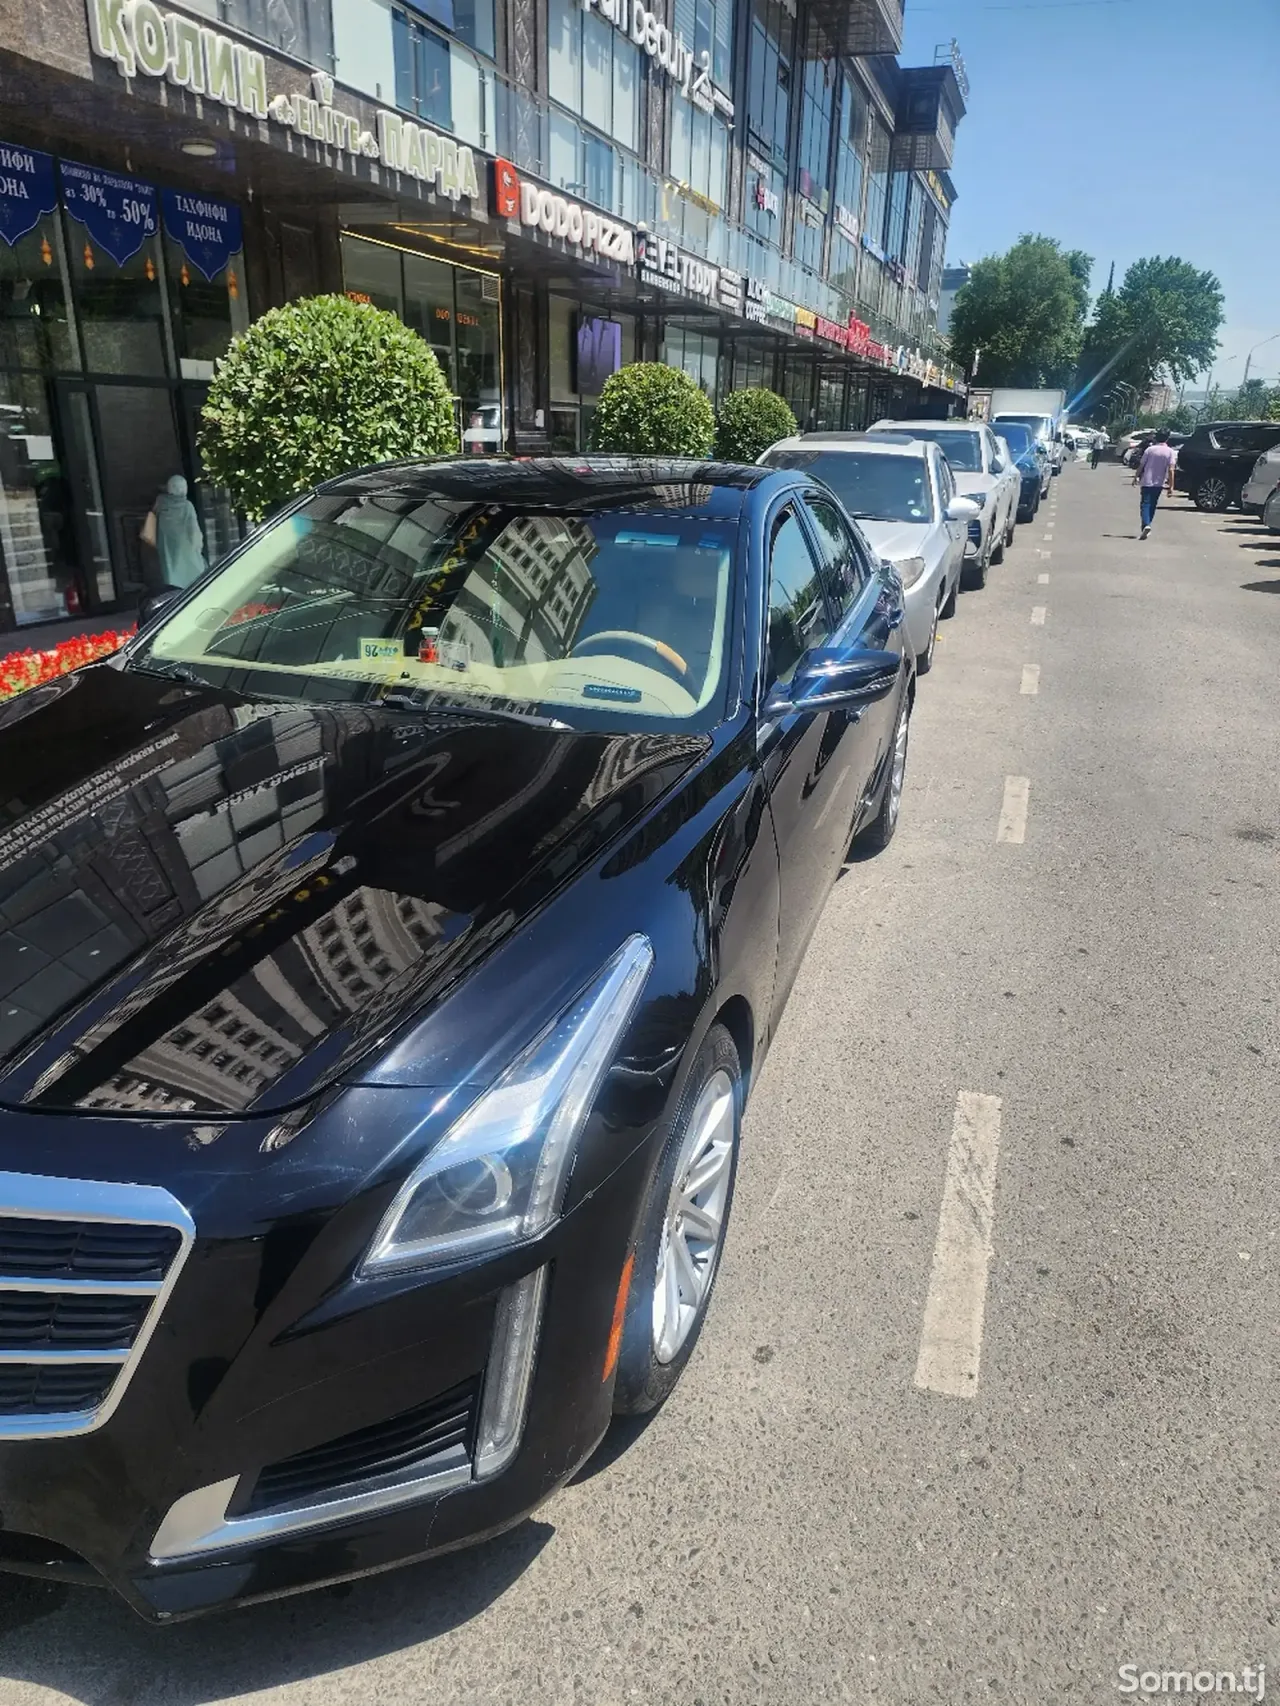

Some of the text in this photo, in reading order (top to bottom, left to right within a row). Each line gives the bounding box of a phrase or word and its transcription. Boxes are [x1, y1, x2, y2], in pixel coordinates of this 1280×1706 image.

[292, 95, 360, 154] ELITE
[377, 110, 478, 200] ПАРДА
[120, 198, 154, 230] -50%
[175, 195, 227, 222] ТАХФИФИ
[520, 182, 634, 266] DODO PIZZA
[186, 220, 223, 244] ИДОНА
[679, 256, 718, 299] TEDDY
